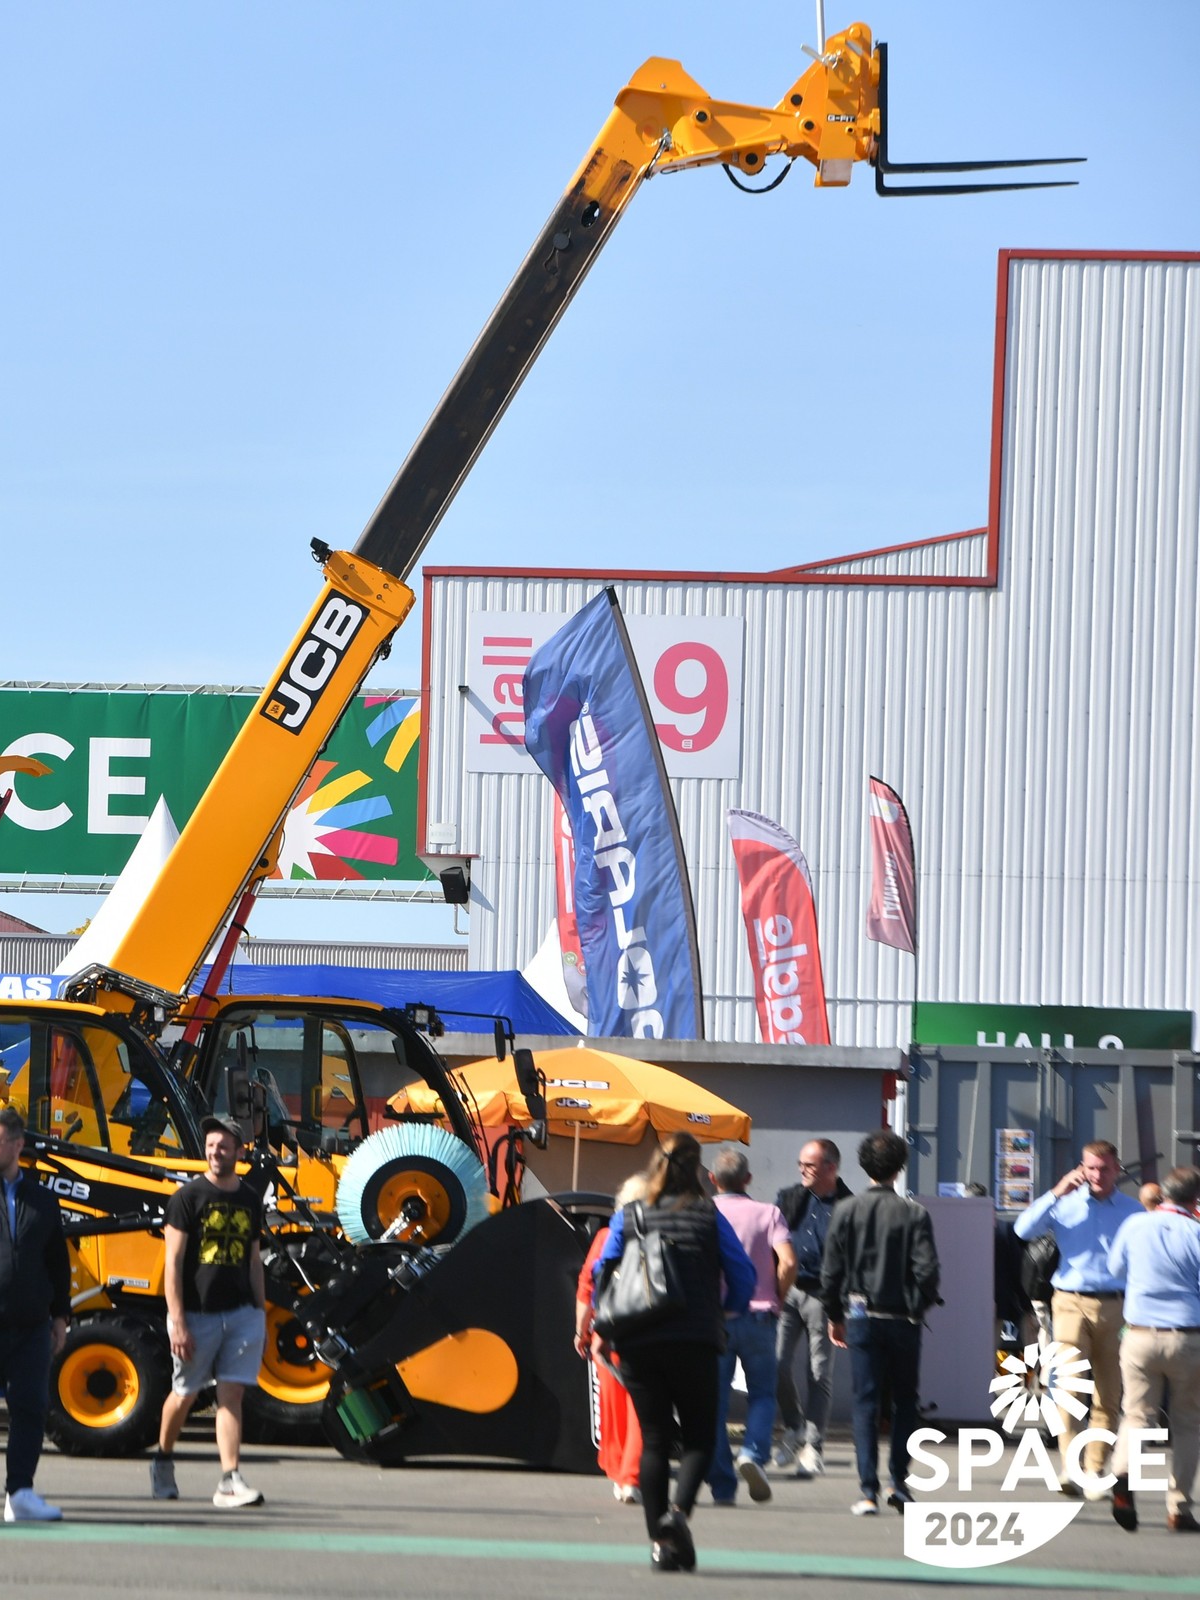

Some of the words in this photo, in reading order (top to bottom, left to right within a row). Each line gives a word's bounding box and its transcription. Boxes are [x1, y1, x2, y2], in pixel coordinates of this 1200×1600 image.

[277, 597, 363, 728] JCB
[480, 637, 533, 745] hall
[653, 642, 729, 753] 9
[545, 1079, 610, 1090] JCB
[39, 1175, 91, 1200] JCB
